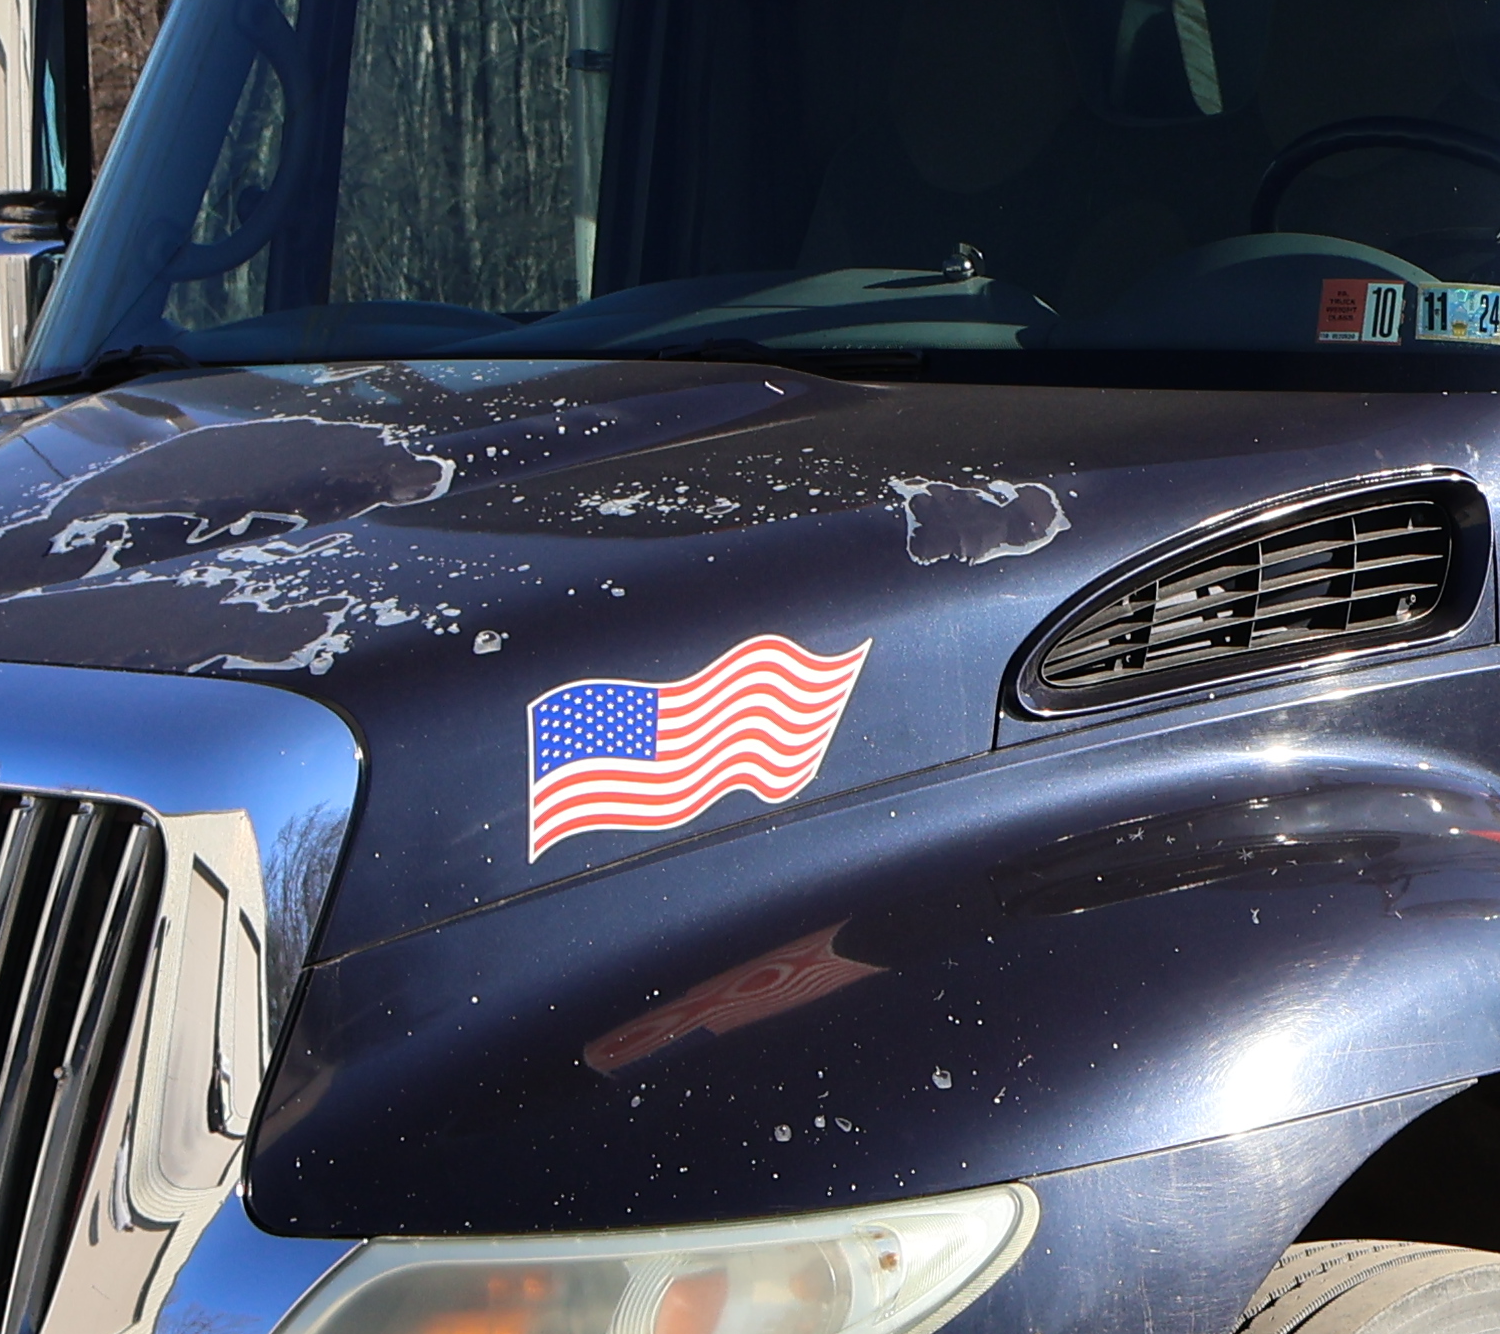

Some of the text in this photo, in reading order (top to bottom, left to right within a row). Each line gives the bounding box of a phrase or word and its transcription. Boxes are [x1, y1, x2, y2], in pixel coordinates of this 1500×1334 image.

[1372, 286, 1397, 339] 10
[1424, 292, 1500, 334] 11 24
